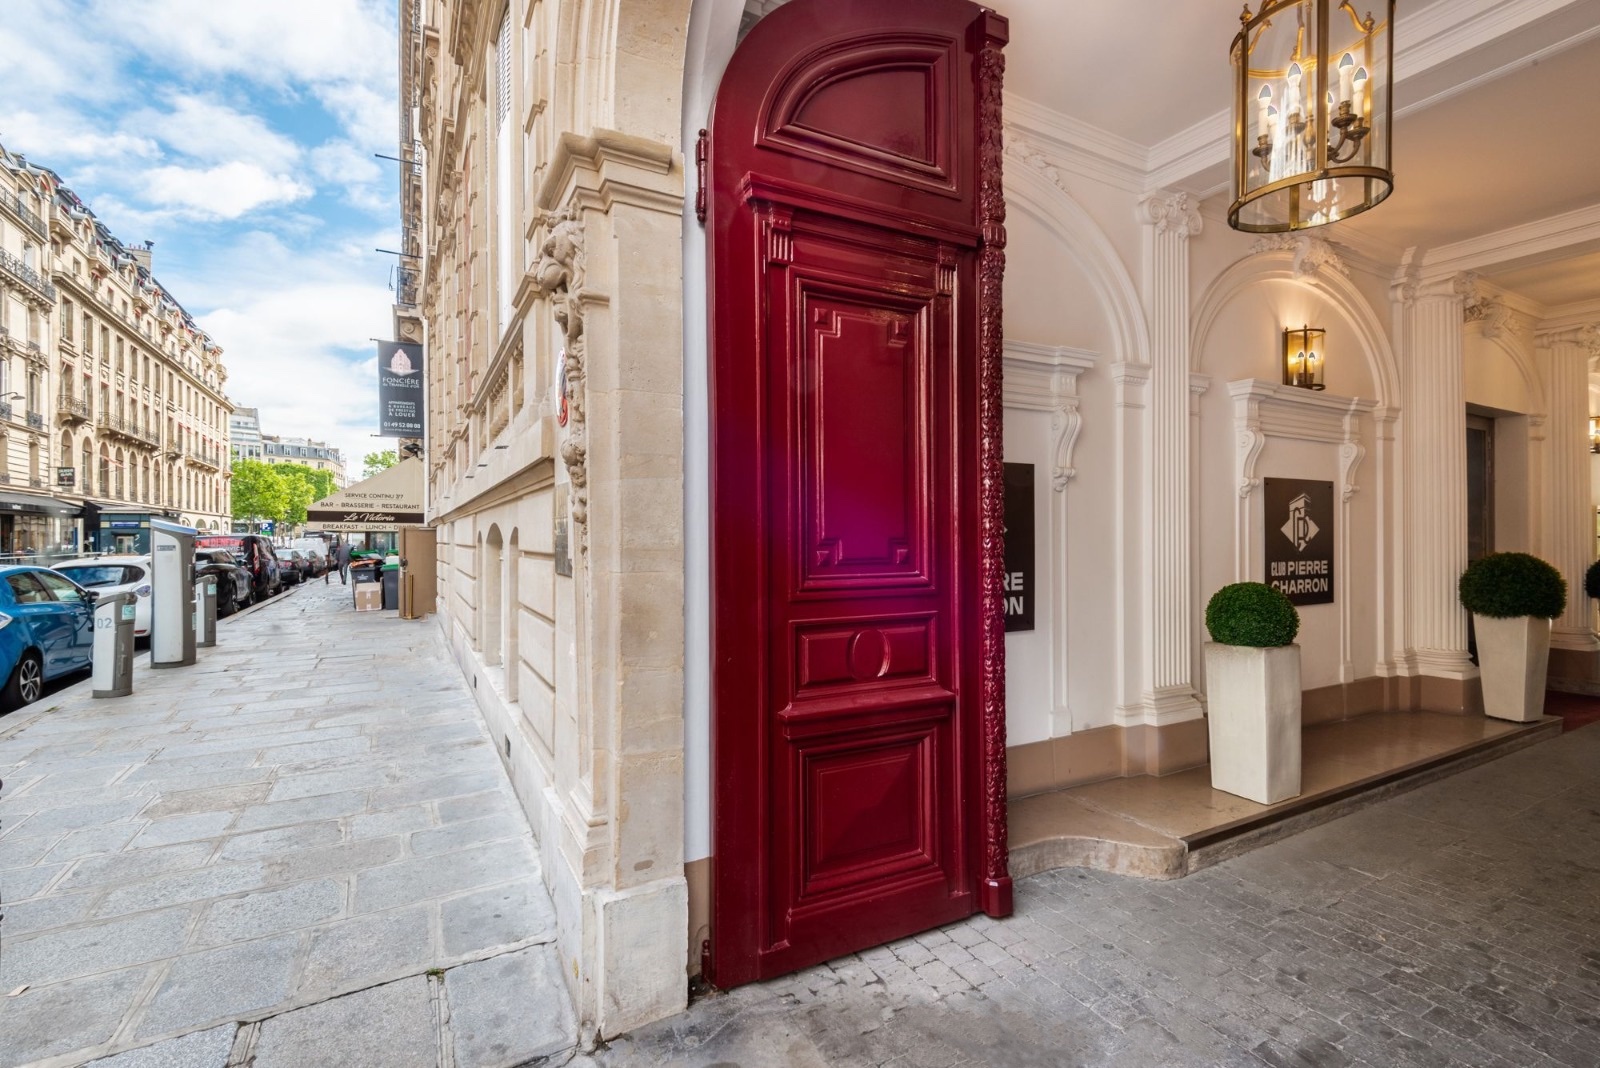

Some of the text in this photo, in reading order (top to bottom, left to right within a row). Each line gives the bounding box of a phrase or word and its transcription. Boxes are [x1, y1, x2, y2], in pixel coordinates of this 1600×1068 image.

[343, 512, 395, 522] Le Victoria
[1271, 560, 1328, 576] CLUB PIERRE
[96, 617, 112, 629] 02
